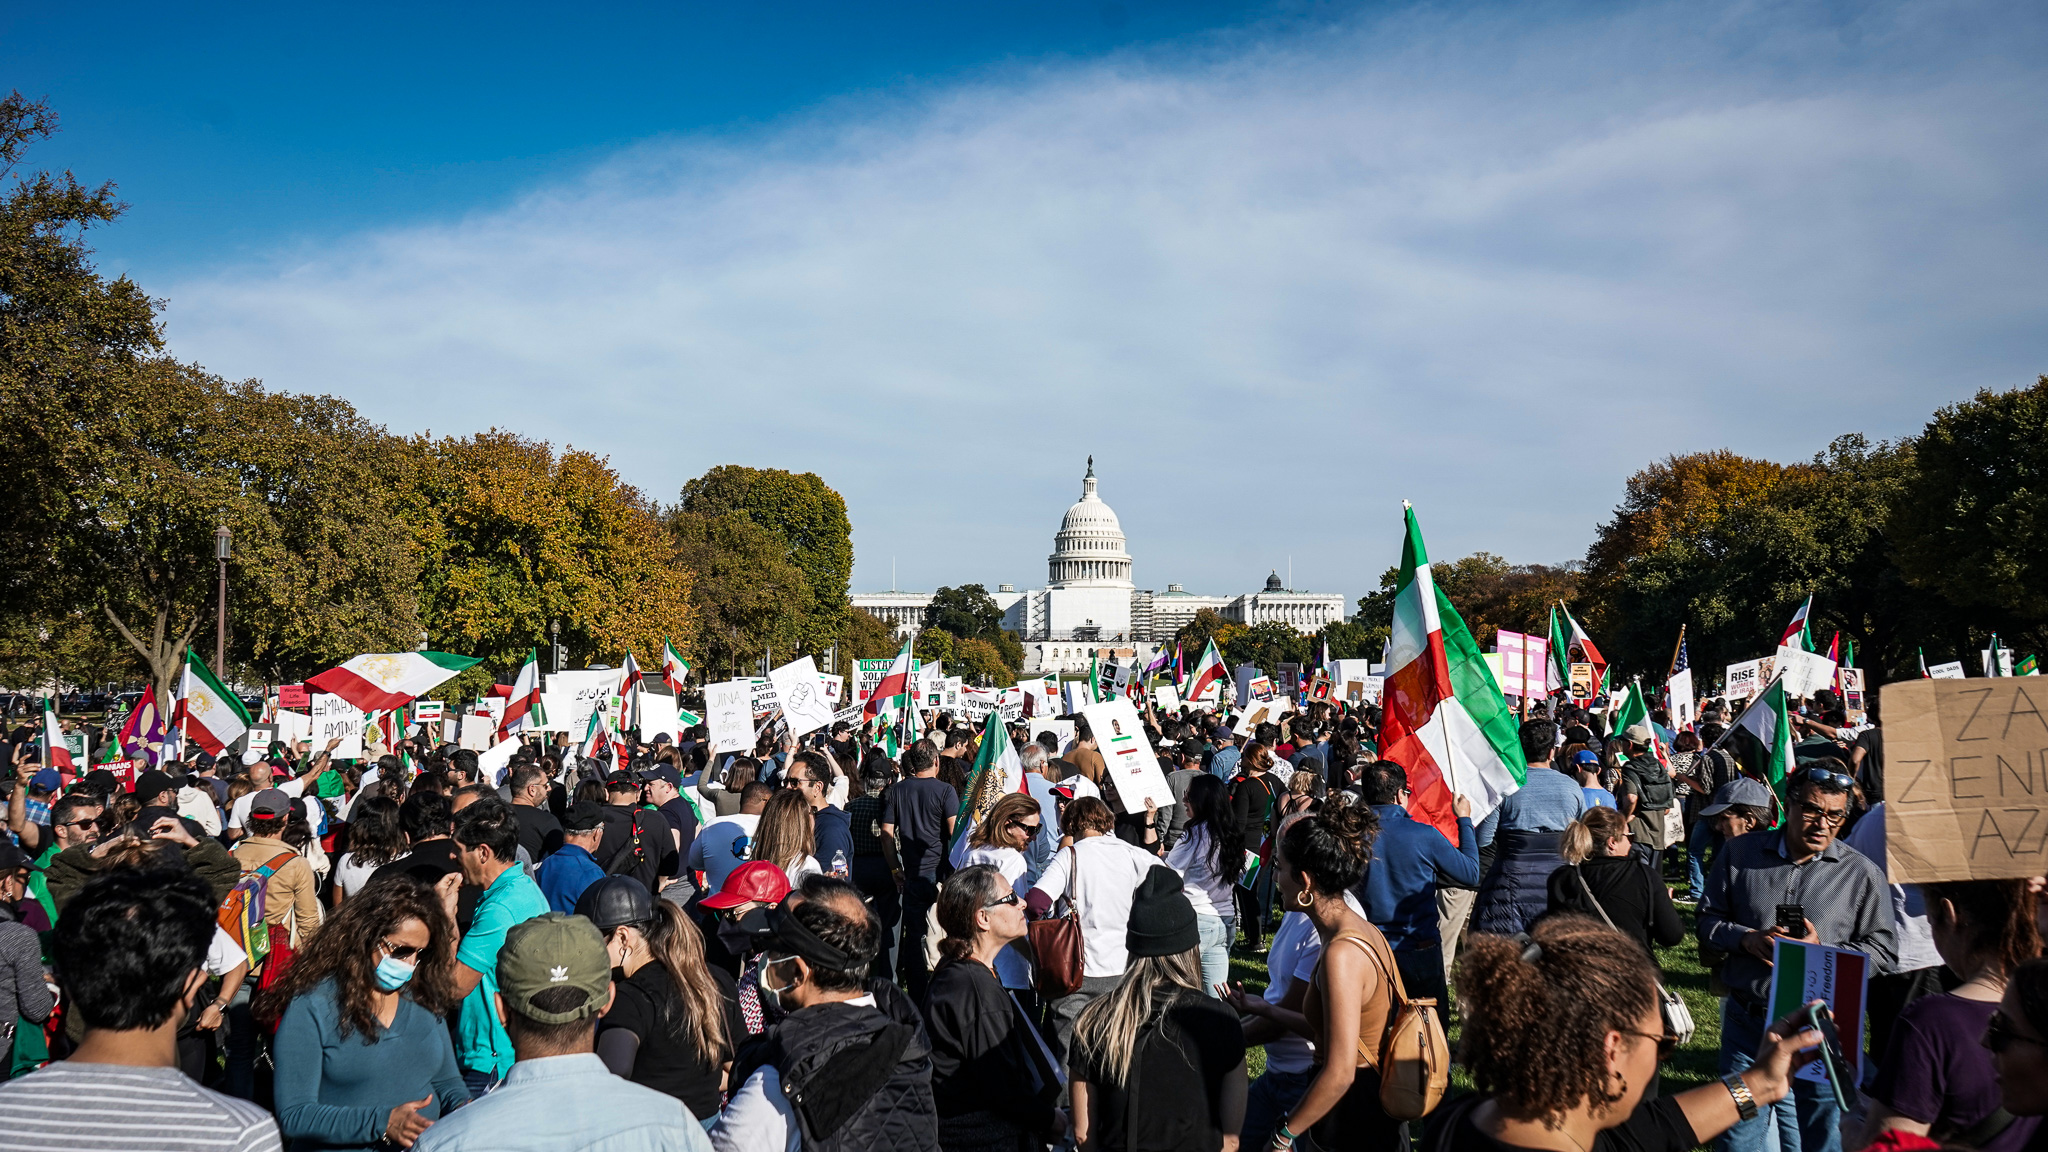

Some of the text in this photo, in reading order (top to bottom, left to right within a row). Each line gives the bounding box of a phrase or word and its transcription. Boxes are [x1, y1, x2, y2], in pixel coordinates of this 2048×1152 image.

[1731, 669, 1754, 682] RISE
[1731, 681, 1754, 690] WOMEN
[979, 701, 992, 710] NOT
[721, 738, 739, 747] me
[1821, 951, 1833, 1000] Freedom
